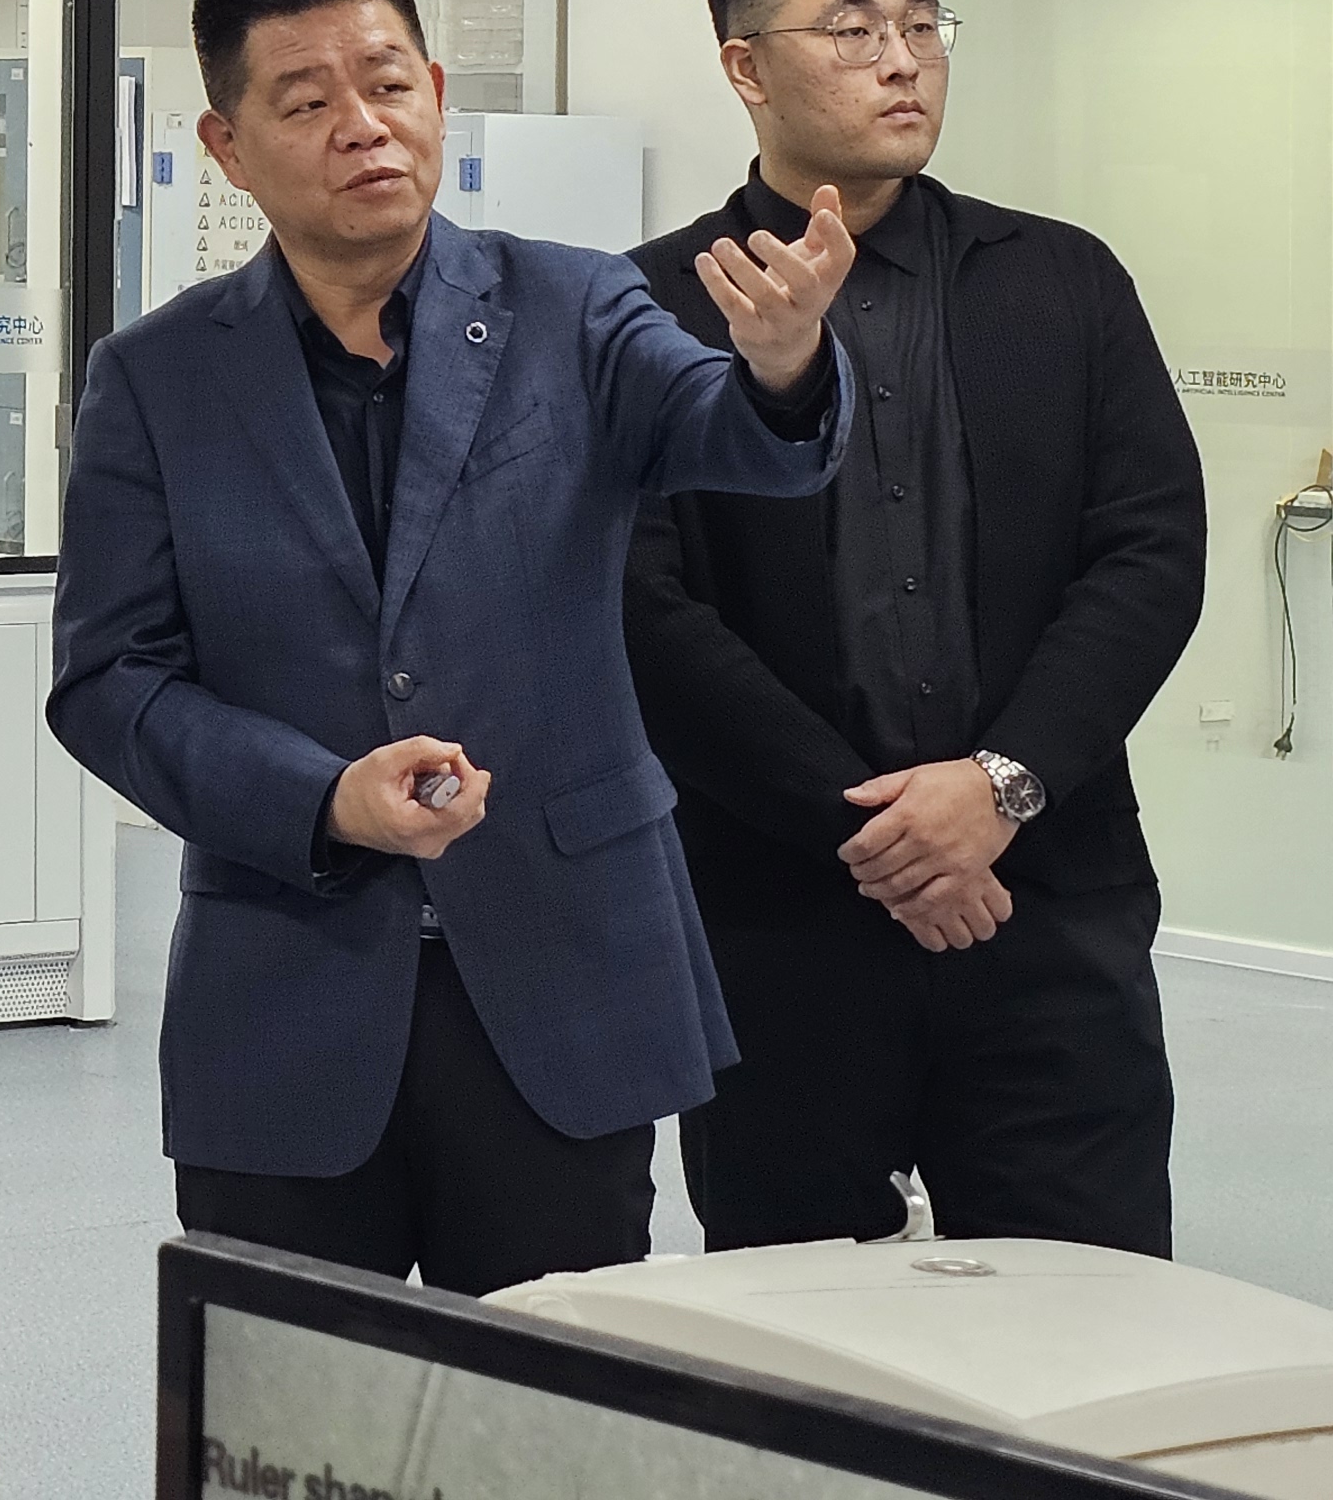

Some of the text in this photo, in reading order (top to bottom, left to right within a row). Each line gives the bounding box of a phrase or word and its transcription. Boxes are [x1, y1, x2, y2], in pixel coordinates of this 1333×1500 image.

[1169, 368, 1286, 390] 人工智能研究中心
[201, 1436, 297, 1500] Ruler
